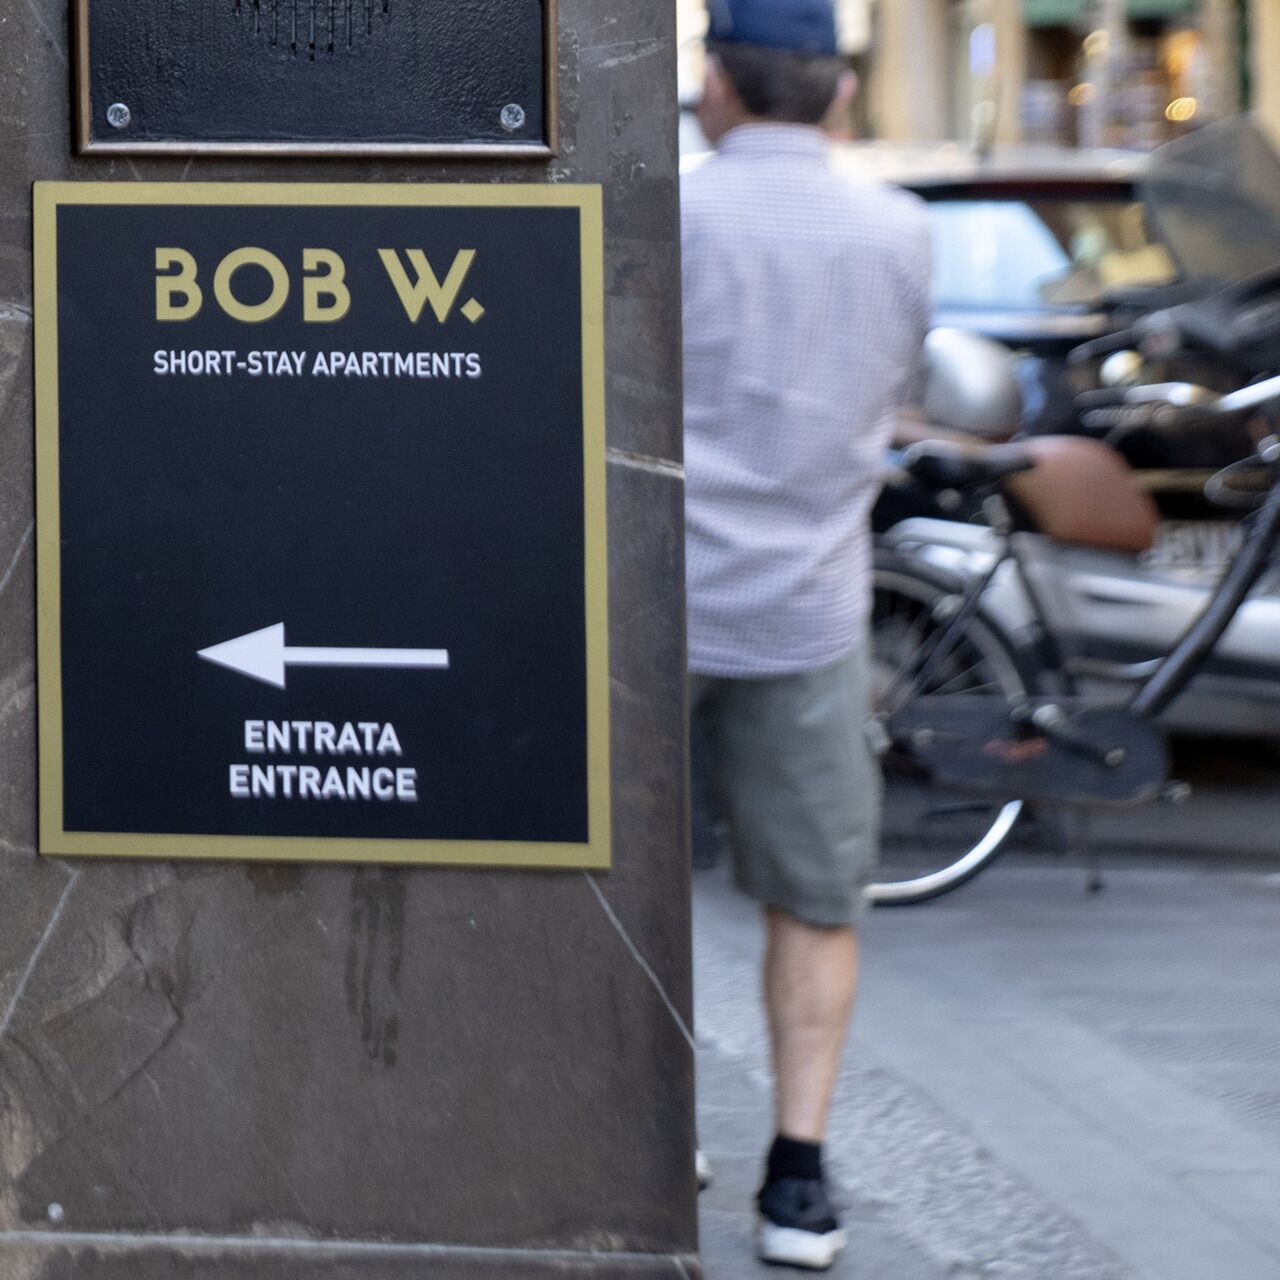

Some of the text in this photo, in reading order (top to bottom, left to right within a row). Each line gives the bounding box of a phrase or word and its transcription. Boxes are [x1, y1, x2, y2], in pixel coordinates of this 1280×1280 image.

[155, 246, 486, 323] BOB W.
[153, 350, 482, 379] SHORT-STAY APARTMENTS
[244, 720, 402, 756] ENTRATA
[229, 764, 417, 801] ENTRANCE
